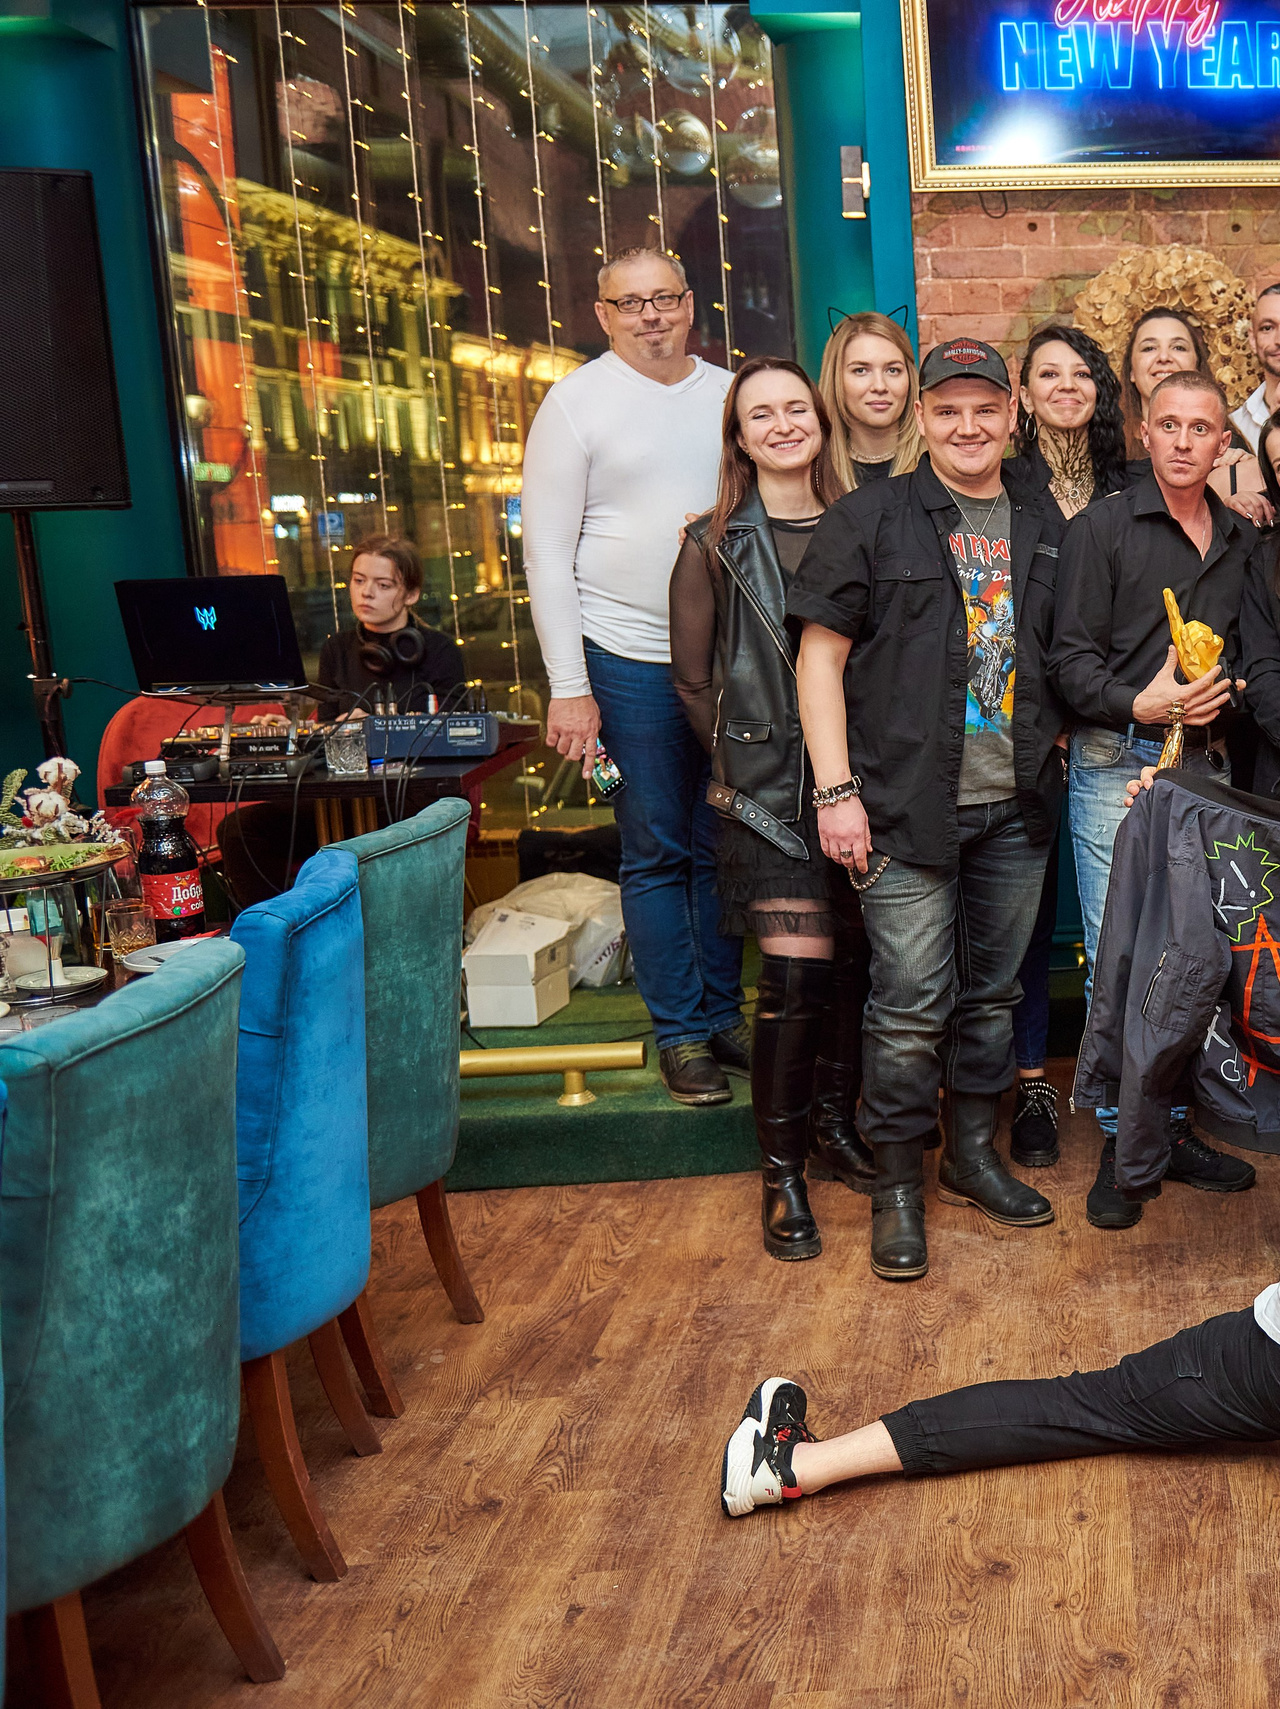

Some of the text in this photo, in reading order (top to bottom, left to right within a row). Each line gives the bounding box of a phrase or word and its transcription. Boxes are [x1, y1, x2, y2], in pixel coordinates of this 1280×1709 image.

[1000, 22, 1136, 90] NEW
[966, 535, 1011, 567] MA
[171, 883, 203, 904] Добр
